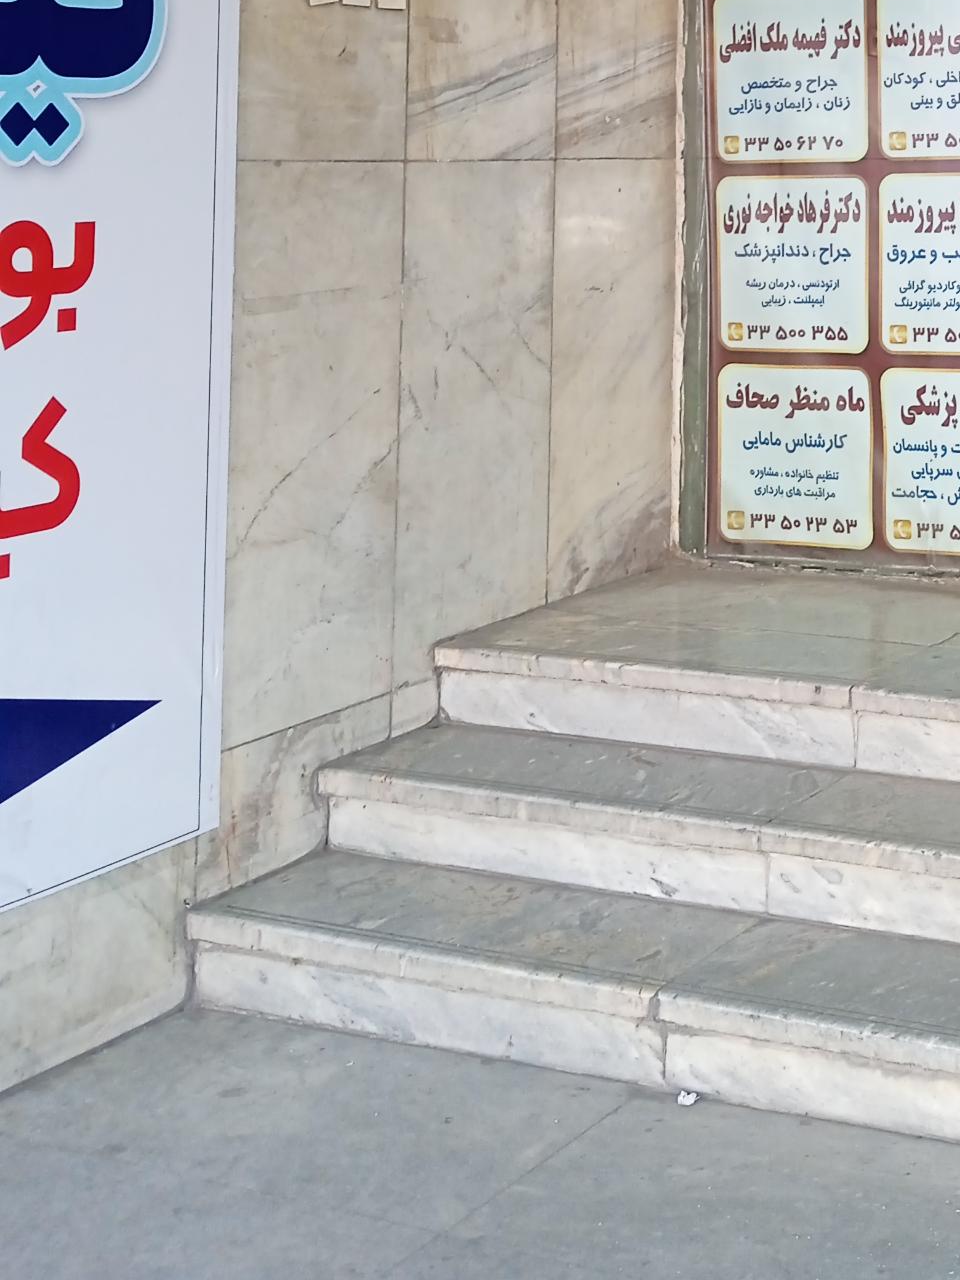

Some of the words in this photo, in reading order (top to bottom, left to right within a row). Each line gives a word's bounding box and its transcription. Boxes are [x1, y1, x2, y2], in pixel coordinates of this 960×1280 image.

[720, 21, 756, 63] افضلی
[760, 22, 788, 52] ملک
[792, 18, 826, 58] فهیمه
[831, 19, 860, 59] دکتر
[886, 22, 944, 56] پیروزمند
[741, 77, 791, 94] متخصص
[795, 80, 802, 92] و
[806, 76, 837, 93] جراح
[884, 72, 926, 89] کودکان
[729, 99, 762, 115] نازایی
[765, 102, 771, 114] و
[774, 97, 812, 112] زایمان
[911, 96, 933, 110] بینی
[937, 97, 943, 109] و
[724, 193, 751, 234] نوری
[755, 193, 794, 233] خواجه
[797, 190, 830, 233] فرهاد
[830, 192, 860, 234] دکتر
[887, 197, 956, 234] پیروزمند
[735, 243, 809, 263] دندانپزشک
[887, 249, 926, 264] عروق
[930, 250, 937, 264] و
[769, 279, 795, 290] درمان
[762, 295, 786, 307] زیبایی
[726, 384, 779, 409] صحاف
[785, 385, 829, 418] منظر
[836, 386, 865, 412] ماه
[901, 384, 958, 429] پزشکی
[743, 431, 781, 450] مامایی
[785, 433, 847, 453] کارشناس
[893, 438, 937, 458] پانسمان
[942, 446, 947, 456] و
[750, 467, 779, 479] مشاوره
[816, 470, 839, 484] تنظیم
[911, 463, 953, 481] سرپایی
[754, 485, 784, 497] بارداری
[786, 487, 802, 498] های
[804, 487, 835, 501] مراقبت
[892, 485, 937, 499] حجامت
